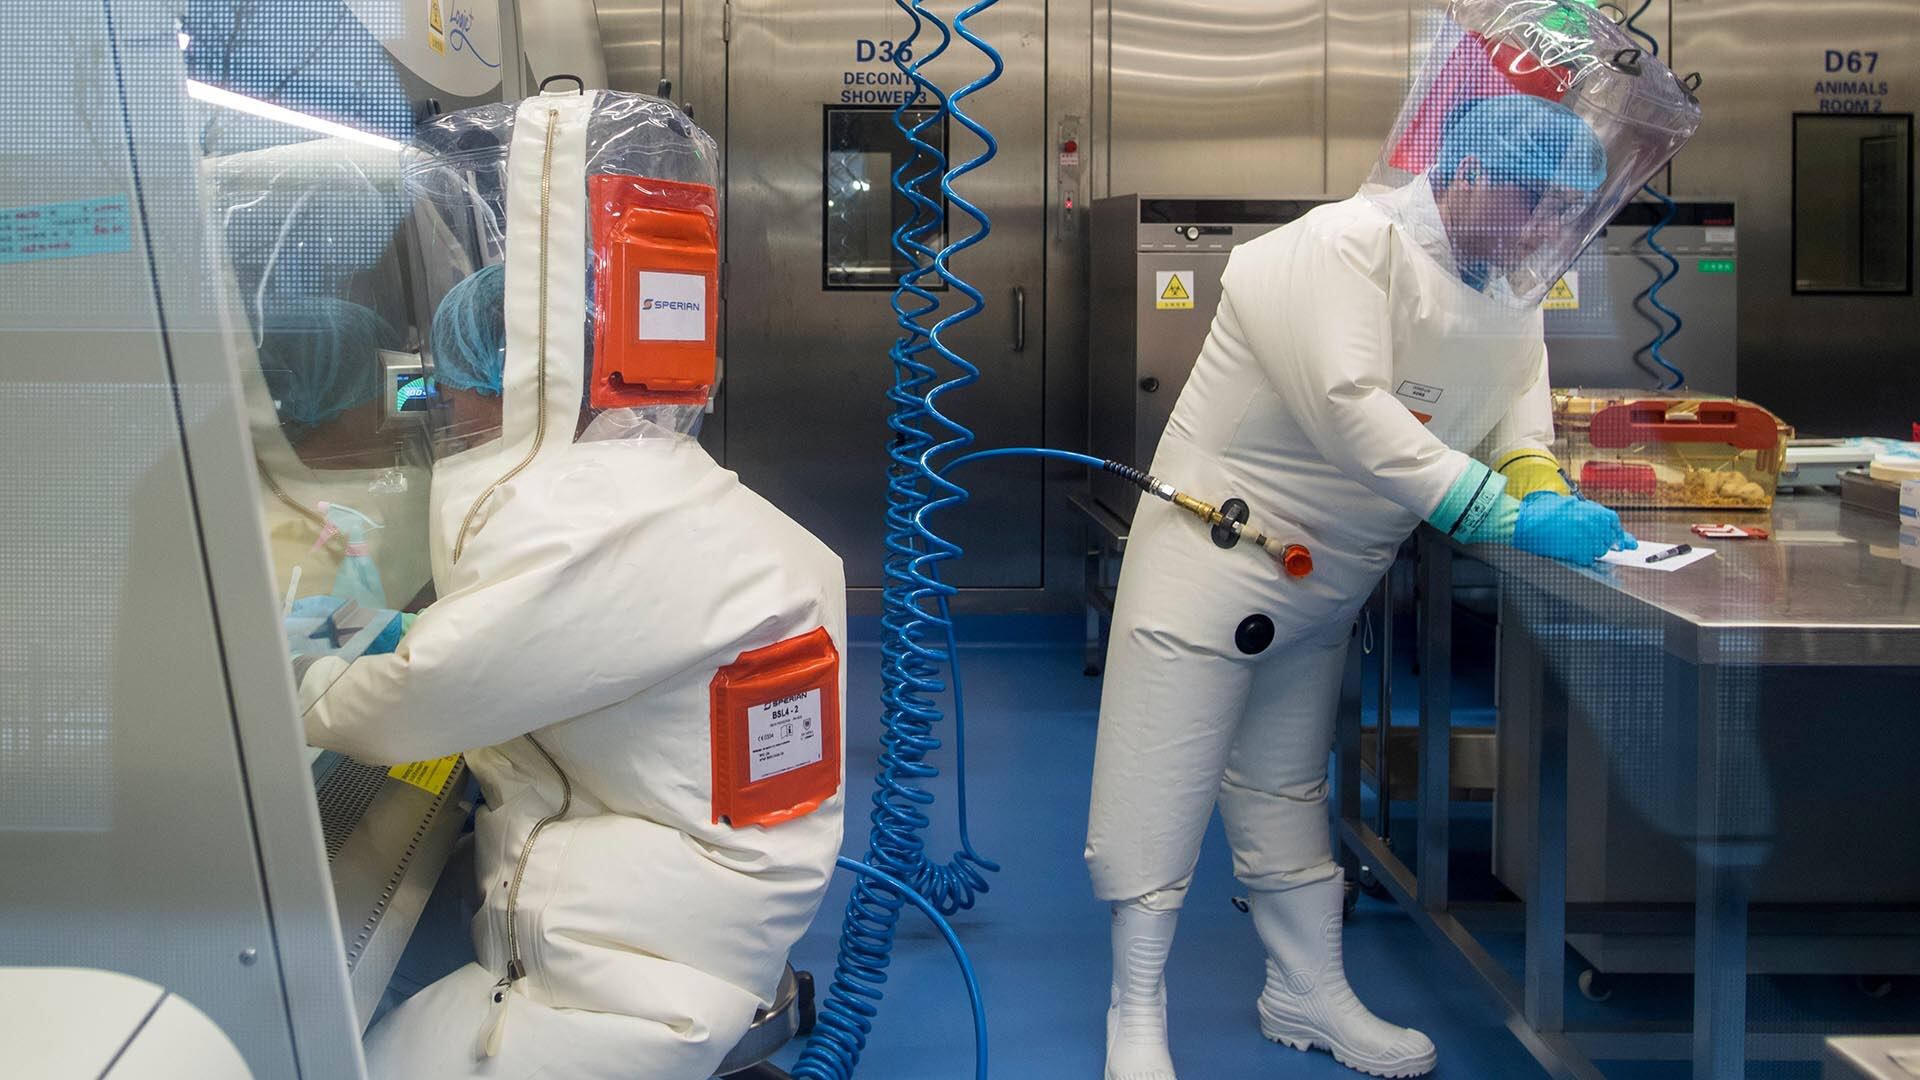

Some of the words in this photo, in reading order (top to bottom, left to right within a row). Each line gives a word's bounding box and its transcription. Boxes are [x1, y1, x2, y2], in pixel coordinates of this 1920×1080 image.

[856, 39, 913, 62] D36
[1825, 51, 1878, 74] D67
[1814, 81, 1888, 96] ANIMALS
[918, 91, 927, 103] 3
[1820, 99, 1869, 113] ROOM
[1872, 99, 1882, 113] 2
[654, 300, 700, 311] SPERIAN
[772, 707, 789, 720] BSL4
[794, 704, 799, 714] 2
